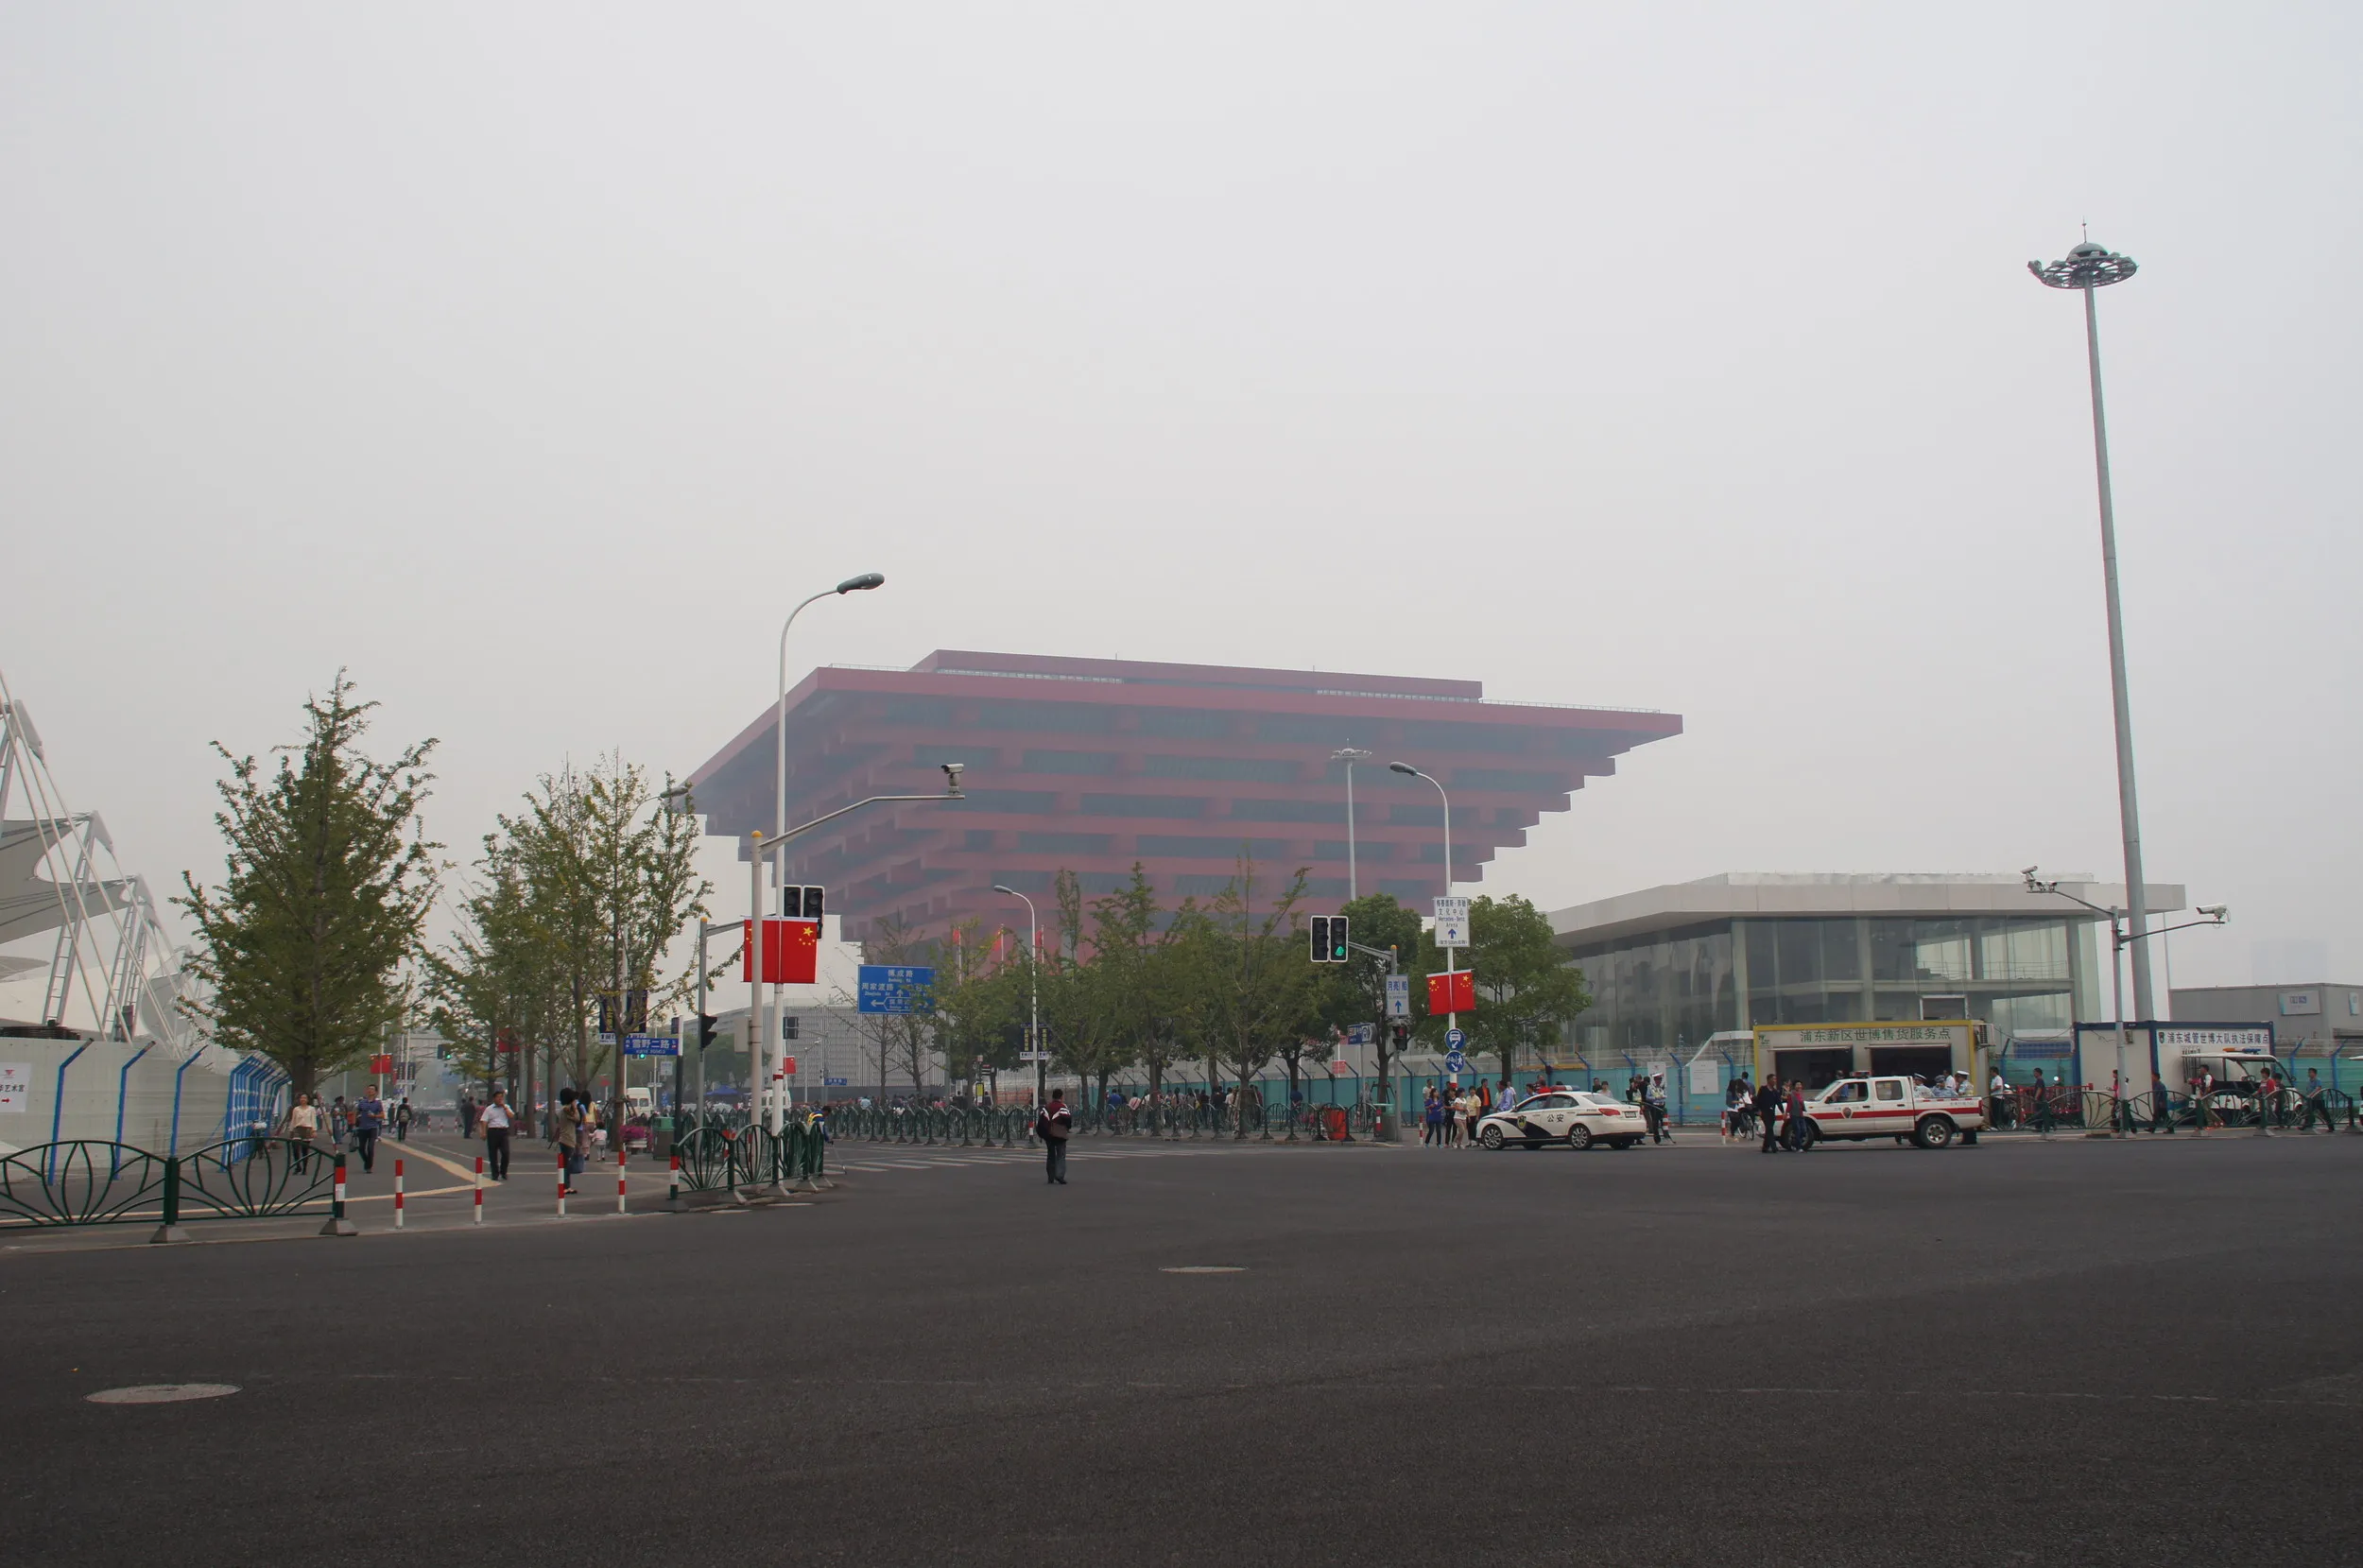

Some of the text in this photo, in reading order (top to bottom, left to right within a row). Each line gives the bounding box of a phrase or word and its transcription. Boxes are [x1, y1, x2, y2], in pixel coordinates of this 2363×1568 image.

[1800, 1027, 1952, 1043] 浦东新区世博售货服务点
[2167, 1031, 2268, 1044] 浦东城管世博大队执法保障点
[632, 1039, 670, 1049] 雪野二路
[1547, 1114, 1564, 1123] 公安
